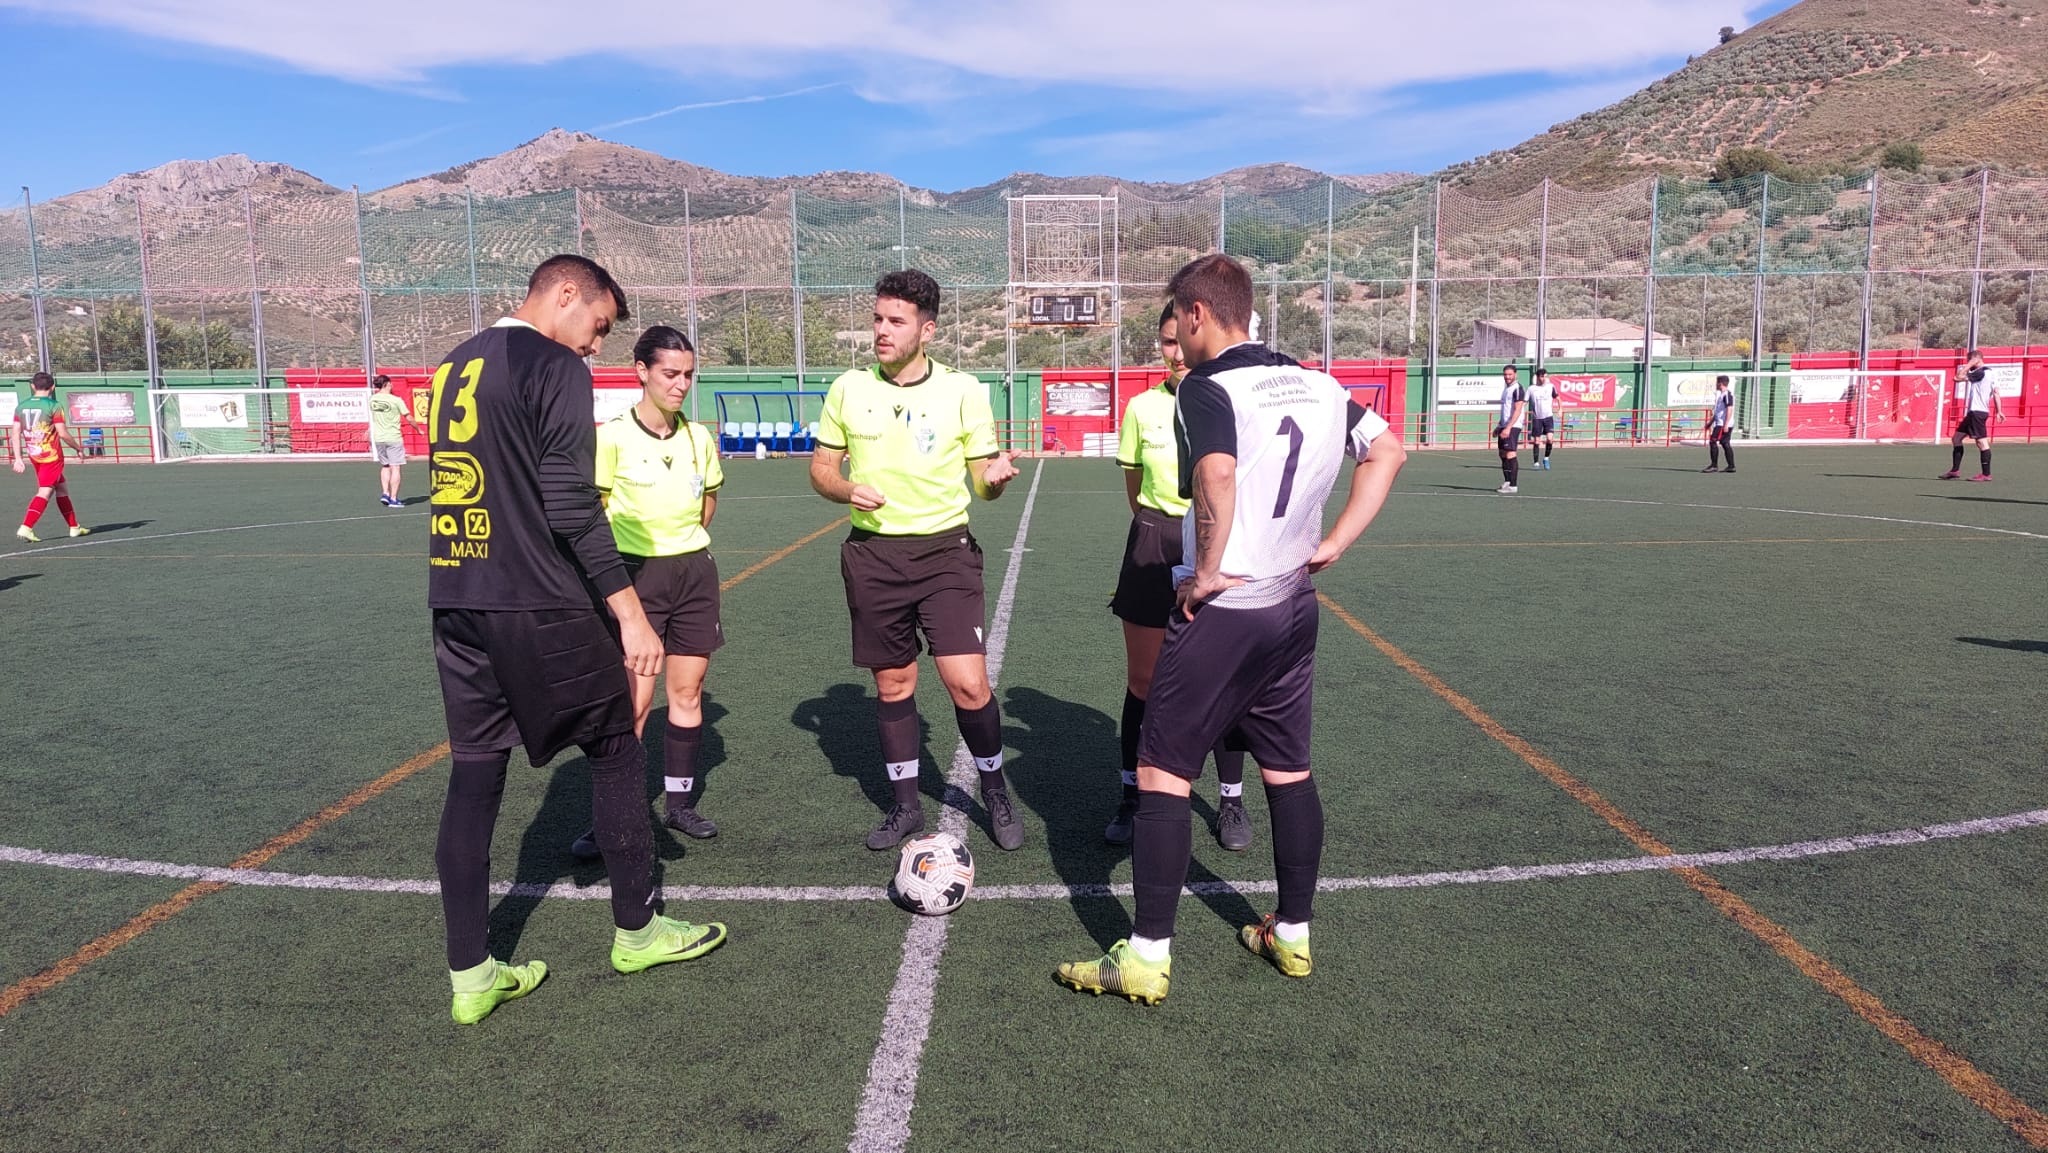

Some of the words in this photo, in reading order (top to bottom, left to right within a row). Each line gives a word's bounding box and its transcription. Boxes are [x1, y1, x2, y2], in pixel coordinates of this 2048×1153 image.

[429, 357, 485, 444] 13
[1049, 392, 1090, 400] CASEMA
[1581, 393, 1603, 402] MAXI
[22, 408, 42, 430] 17
[1272, 415, 1304, 519] 1
[451, 541, 489, 559] MAXI
